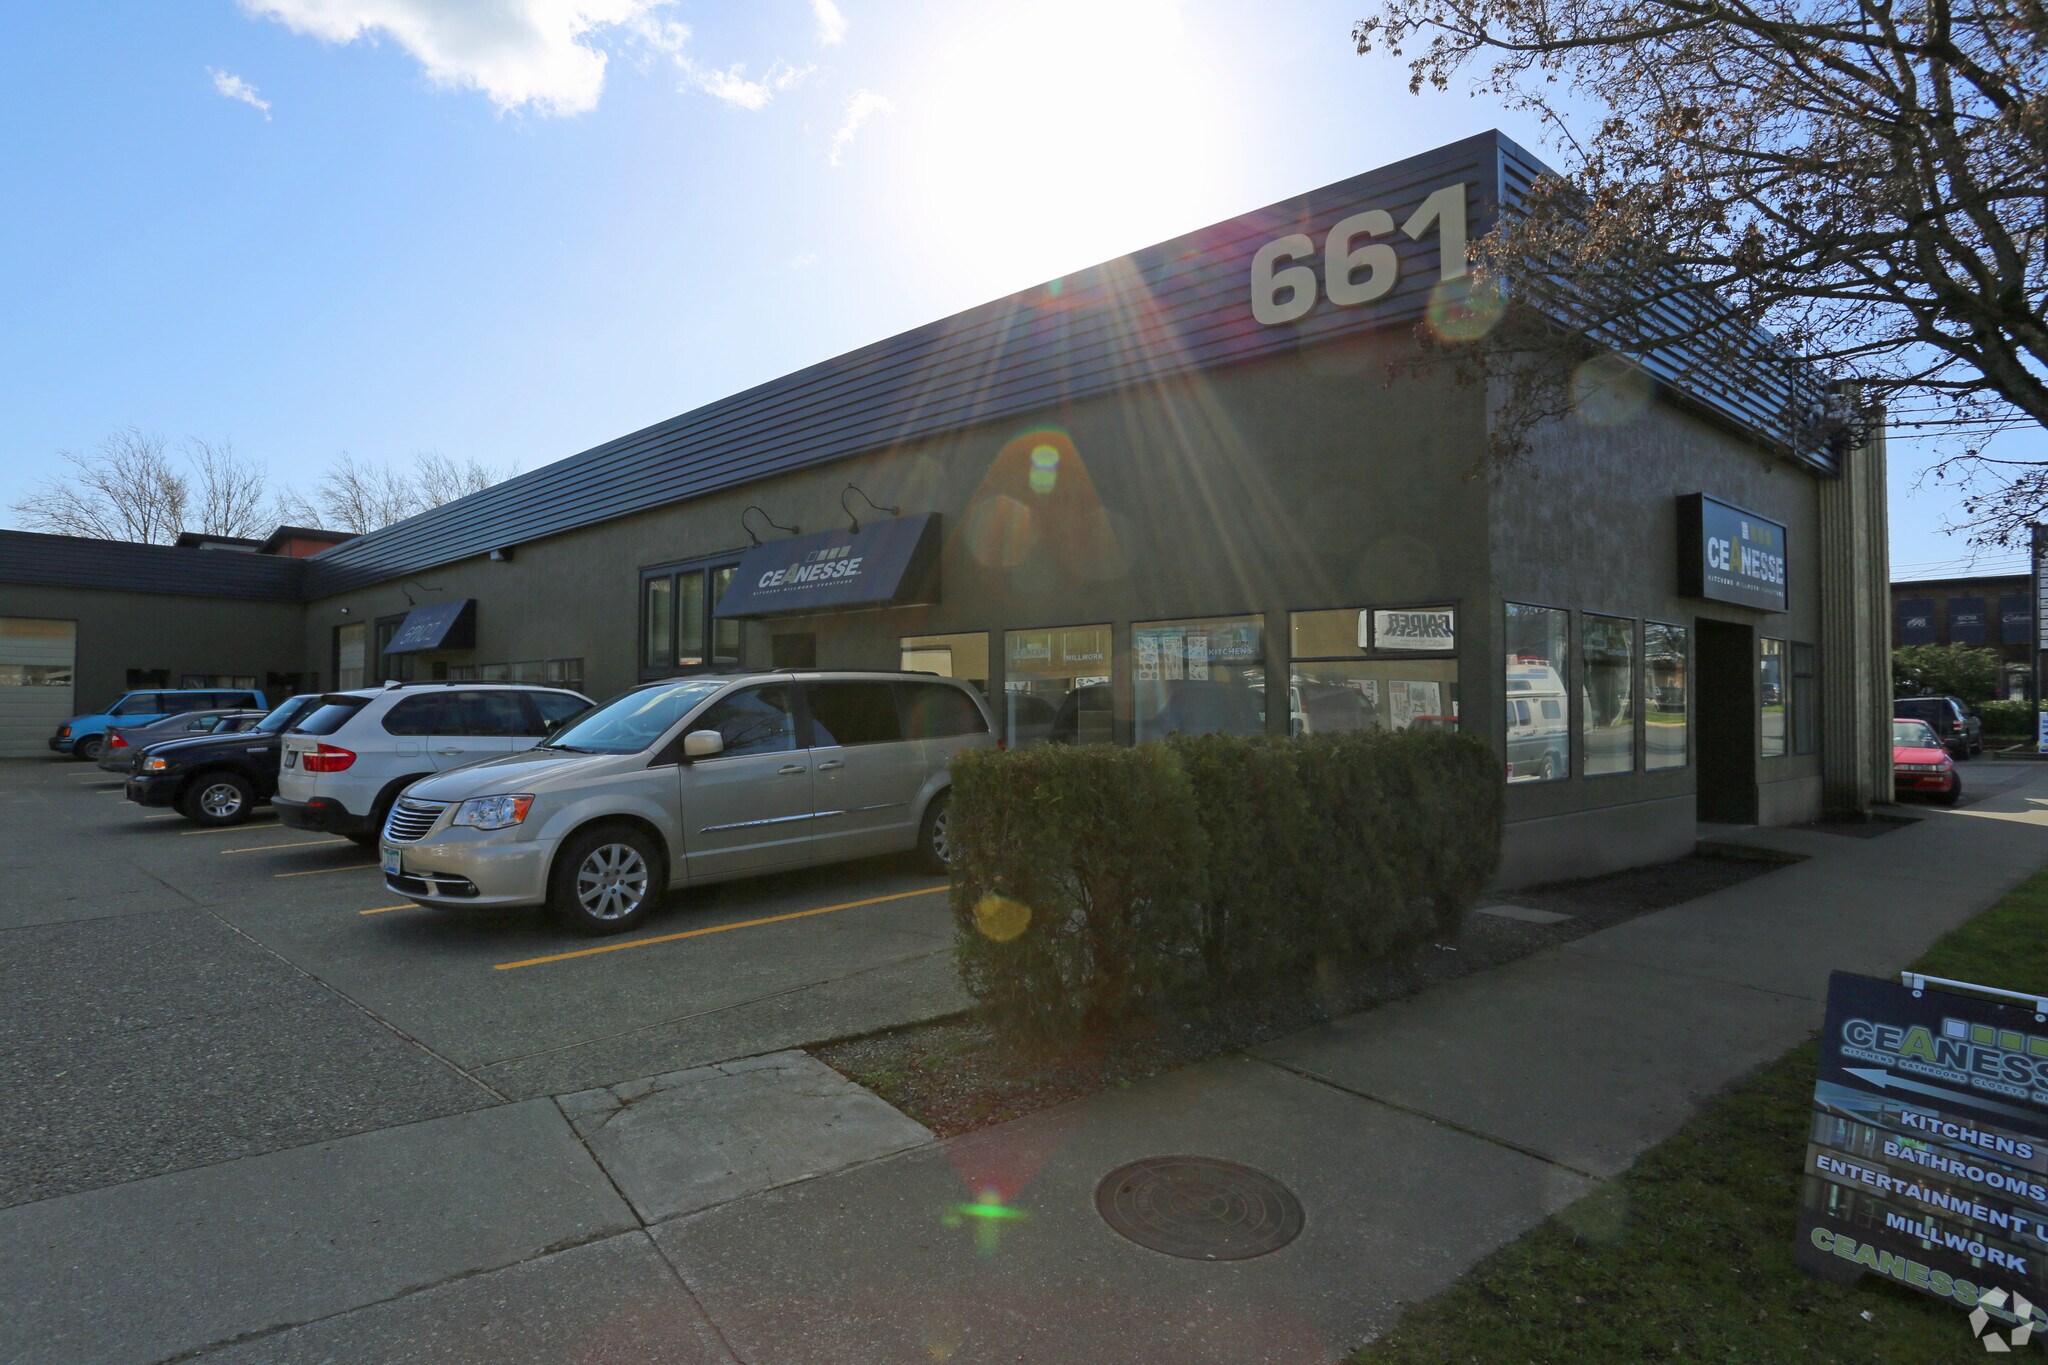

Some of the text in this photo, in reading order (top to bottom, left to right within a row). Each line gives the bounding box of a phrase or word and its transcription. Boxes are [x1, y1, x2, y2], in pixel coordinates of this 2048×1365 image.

[1251, 183, 1467, 325] 661
[758, 557, 863, 588] CEANESSE
[1708, 536, 1783, 584] CEANESSE
[1066, 653, 1103, 661] MILLWORK
[1208, 648, 1252, 656] KITCHENS
[1844, 1047, 1894, 1064] KITCHENS
[1901, 1061, 1966, 1081] BATHROOMS
[1974, 1079, 2026, 1096] CLOSETS
[1902, 1111, 2033, 1159] KITCHENS
[1816, 1154, 2028, 1233] ENTERTAINMENT
[1884, 1141, 2046, 1202] BATHROOMS
[1886, 1212, 2027, 1275] MILLWORK
